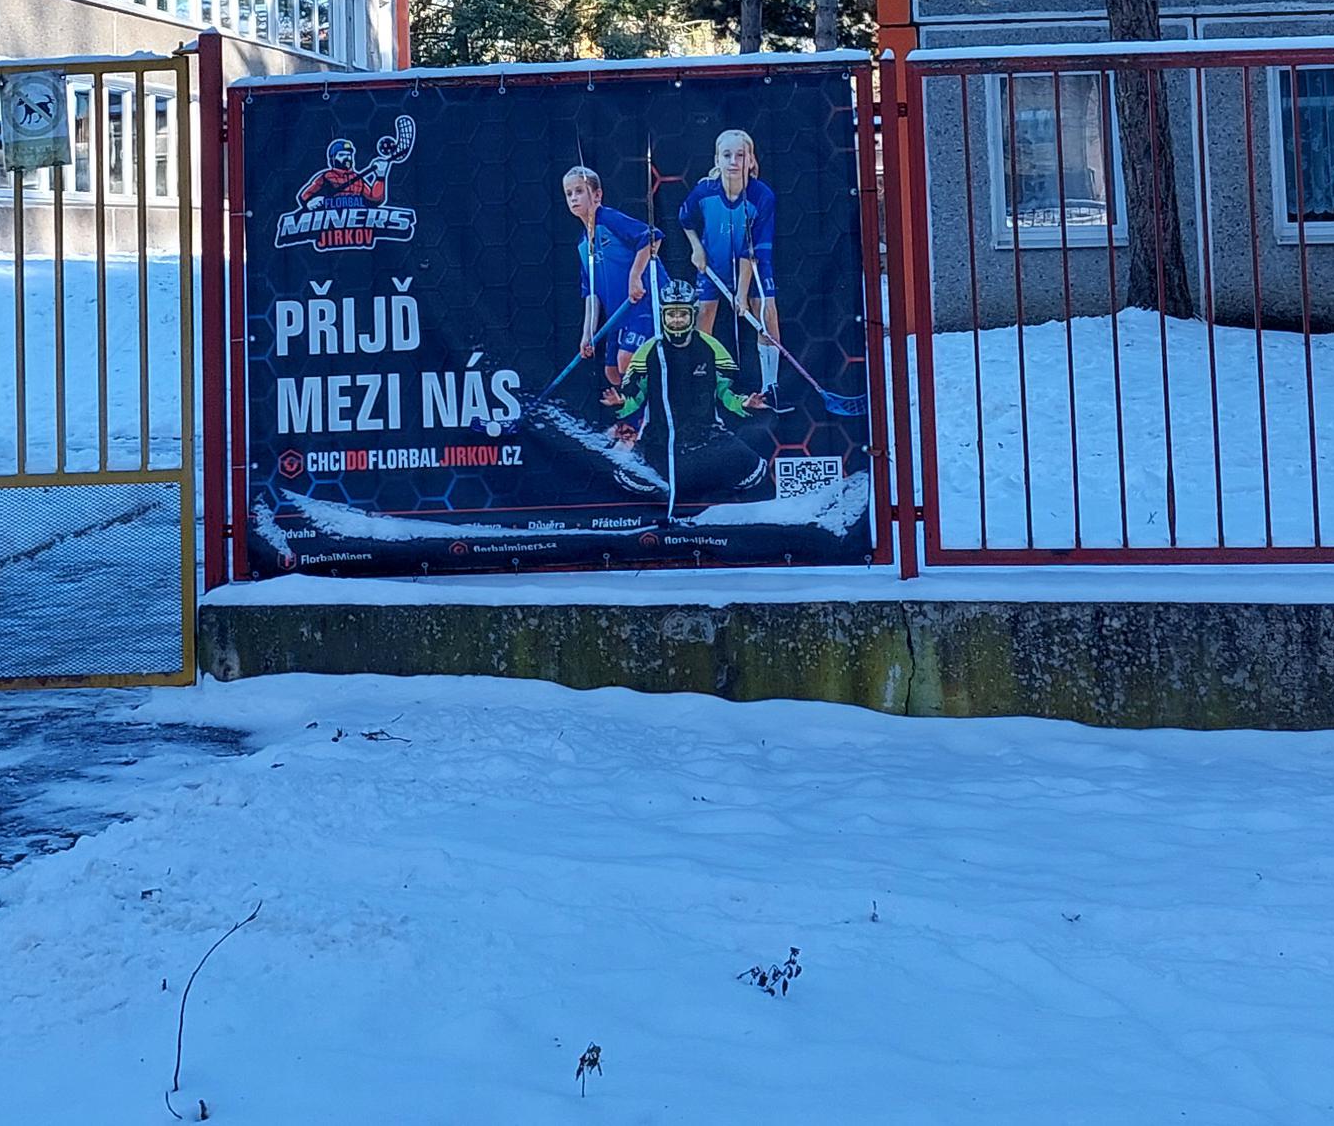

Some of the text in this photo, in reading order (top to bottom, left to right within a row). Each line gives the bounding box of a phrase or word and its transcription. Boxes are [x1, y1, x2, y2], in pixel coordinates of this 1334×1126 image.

[324, 196, 365, 209] FLORBAL
[280, 208, 412, 237] MINERS
[317, 229, 374, 248] JIRKOV
[275, 276, 420, 356] PŘIJĎ
[276, 351, 521, 434] MEZI NÁS
[306, 445, 523, 472] CHCIDOFLORBALJIRKOV.CZ
[591, 516, 642, 529] Přátelství
[300, 552, 372, 565] FlorbalMiners
